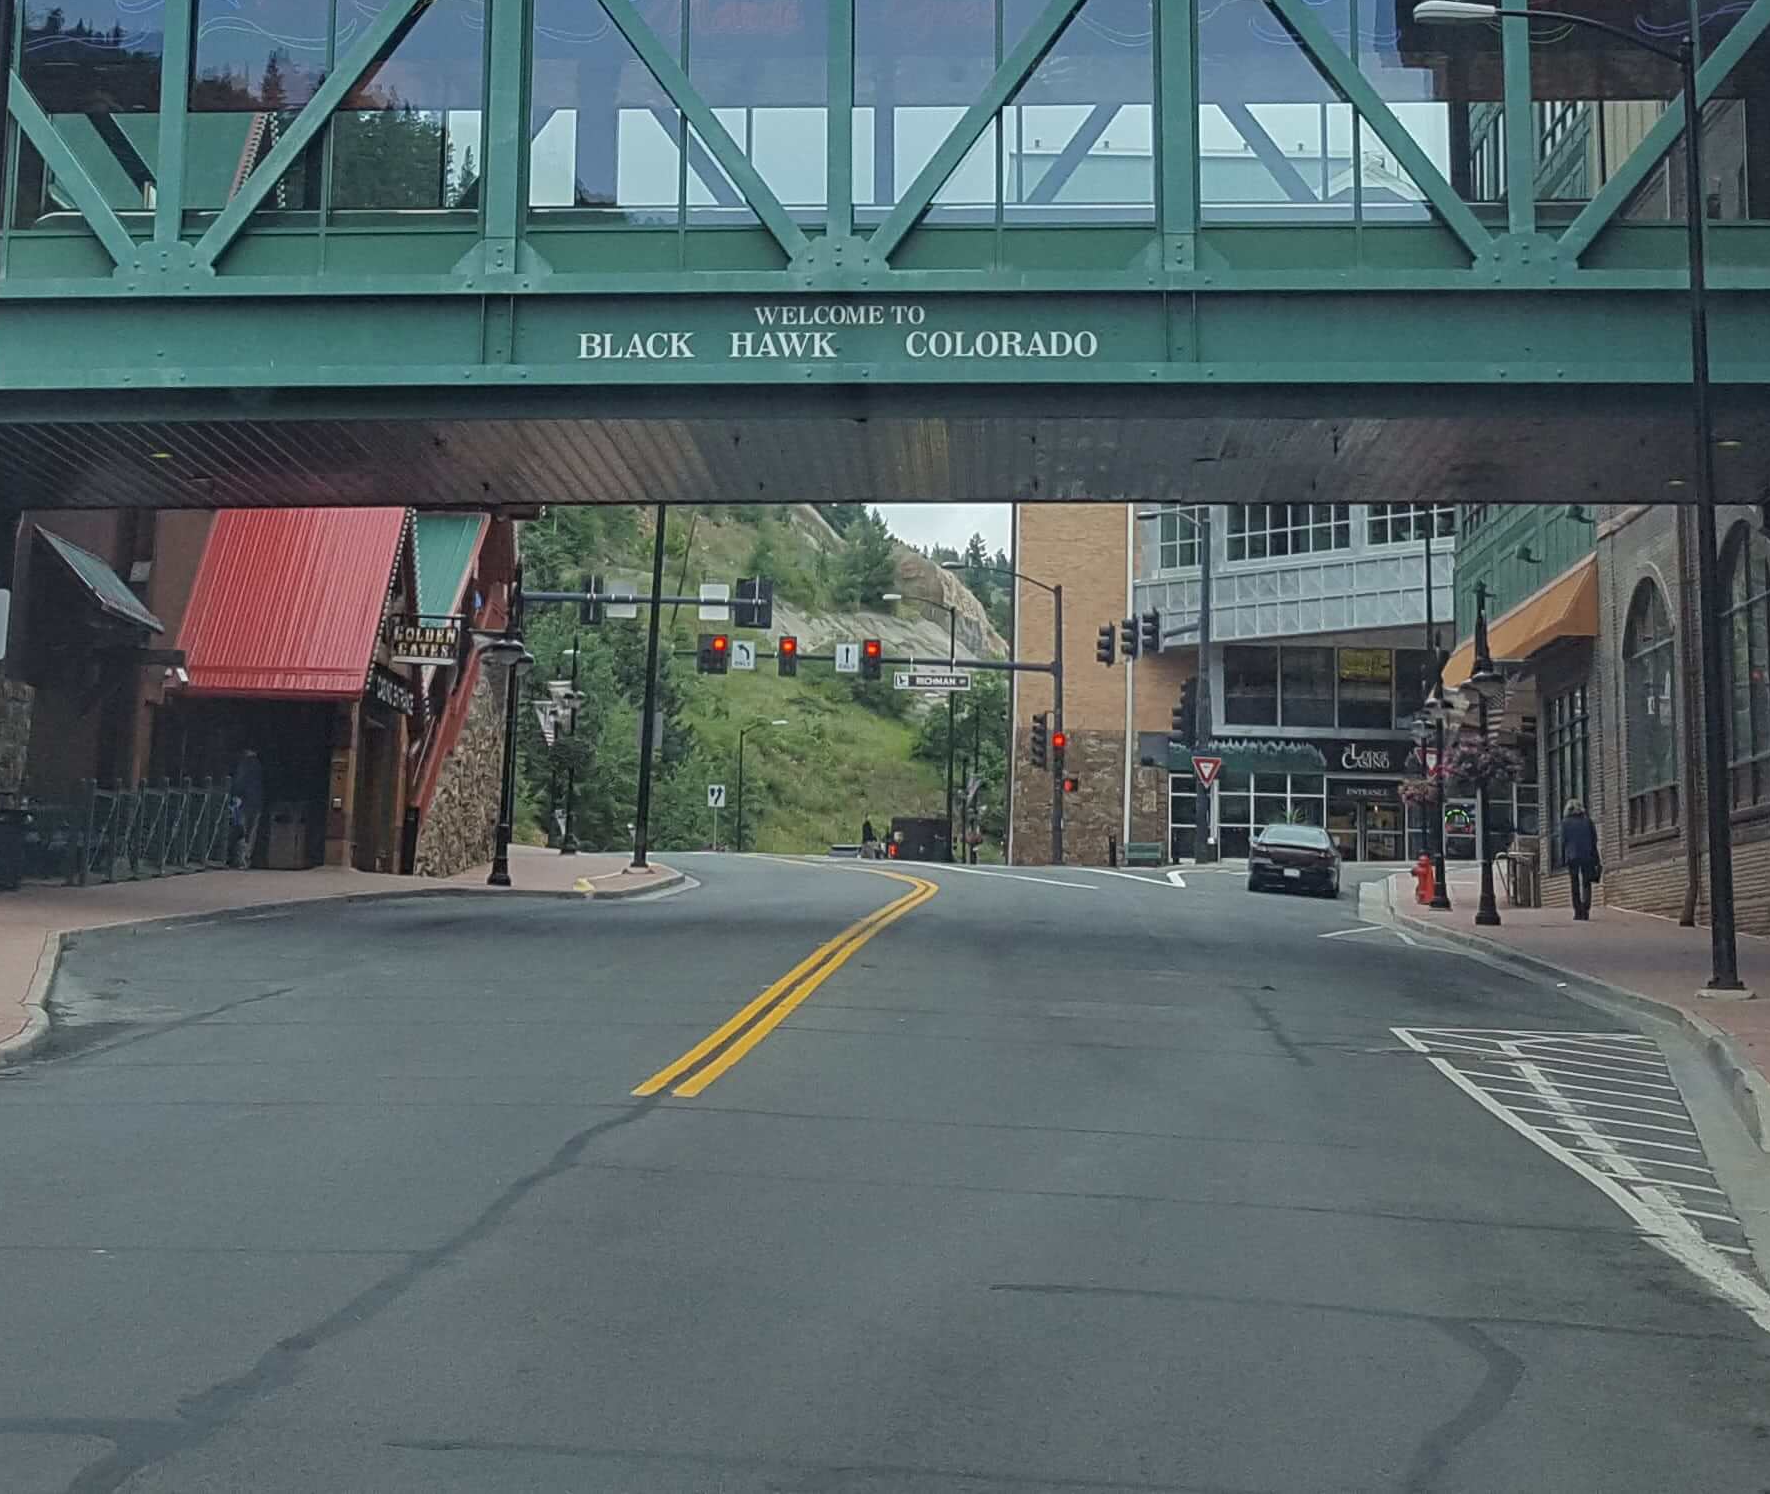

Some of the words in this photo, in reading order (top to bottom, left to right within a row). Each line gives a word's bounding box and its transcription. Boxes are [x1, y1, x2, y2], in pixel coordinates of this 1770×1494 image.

[754, 306, 885, 326] WELCOME
[891, 305, 926, 325] TO
[577, 332, 696, 359] BLACK
[728, 331, 838, 358] HAWK
[905, 330, 1098, 358] COLORADO
[393, 625, 456, 643] GOLDEN
[397, 642, 450, 657] GATES
